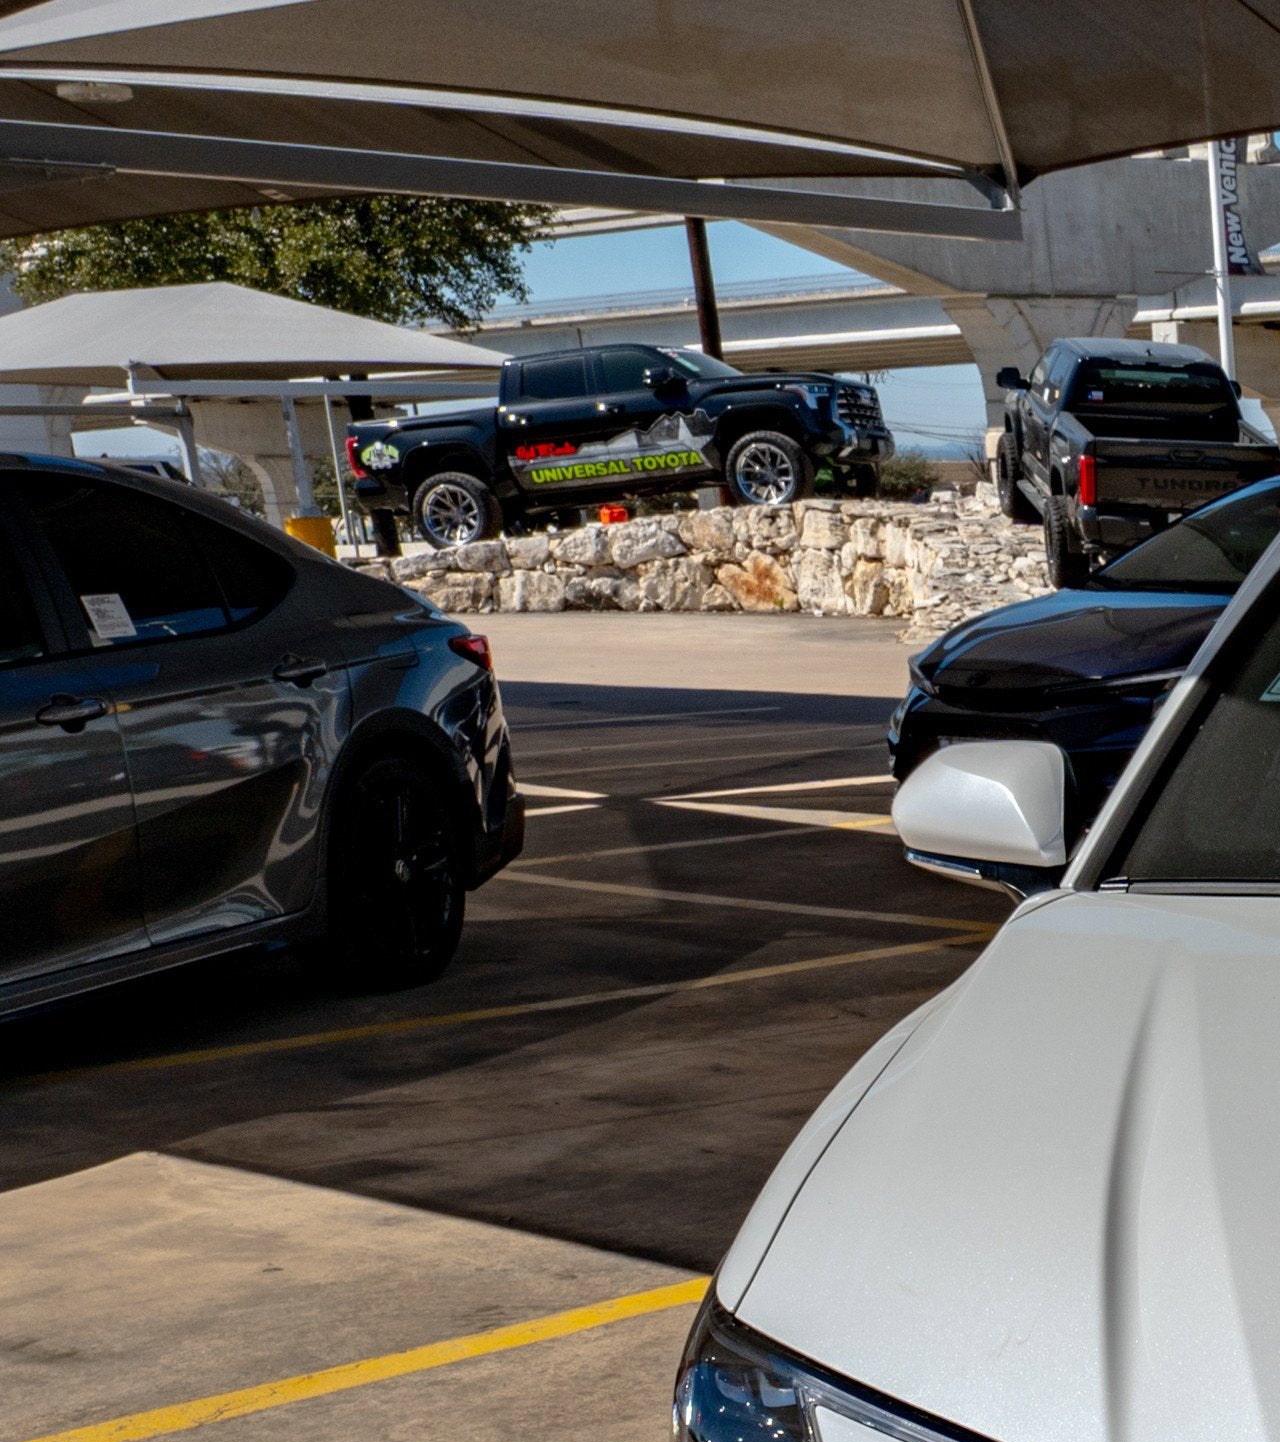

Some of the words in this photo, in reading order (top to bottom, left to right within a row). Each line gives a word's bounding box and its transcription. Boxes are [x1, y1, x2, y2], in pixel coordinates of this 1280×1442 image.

[1219, 137, 1238, 207] Vehic
[1225, 211, 1249, 265] New
[531, 459, 631, 484] UNIVERSAL
[632, 451, 703, 473] TOYOTA
[1137, 477, 1237, 491] TUNDRA
